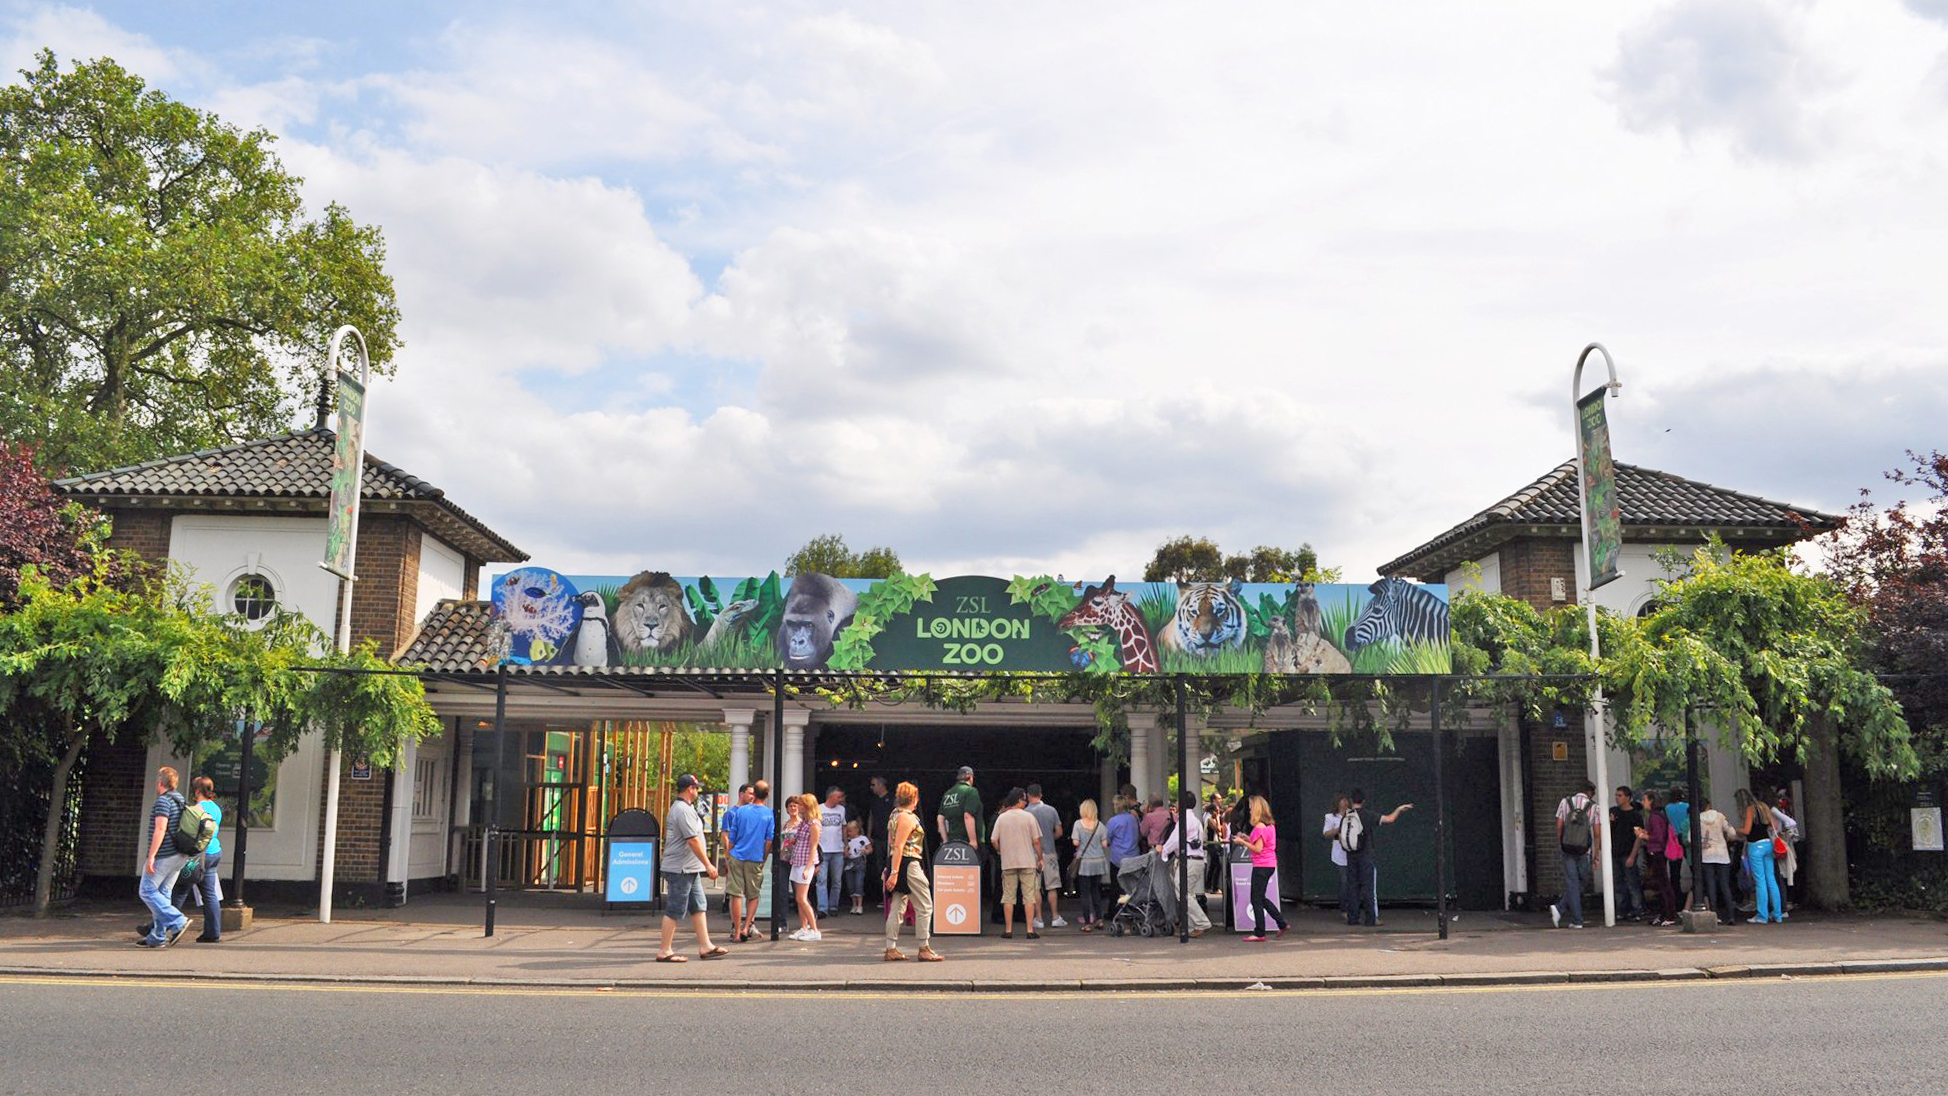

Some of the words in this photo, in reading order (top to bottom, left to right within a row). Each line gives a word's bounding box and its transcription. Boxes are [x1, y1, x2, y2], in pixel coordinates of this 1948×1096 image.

[339, 382, 361, 407] LONDON
[343, 398, 356, 416] ZOO
[1586, 413, 1602, 429] ZOO
[956, 596, 991, 614] ZSL
[917, 617, 1030, 639] LONDON
[942, 643, 1004, 665] ZOO
[943, 792, 960, 806] ZSL
[944, 847, 970, 861] ZSL
